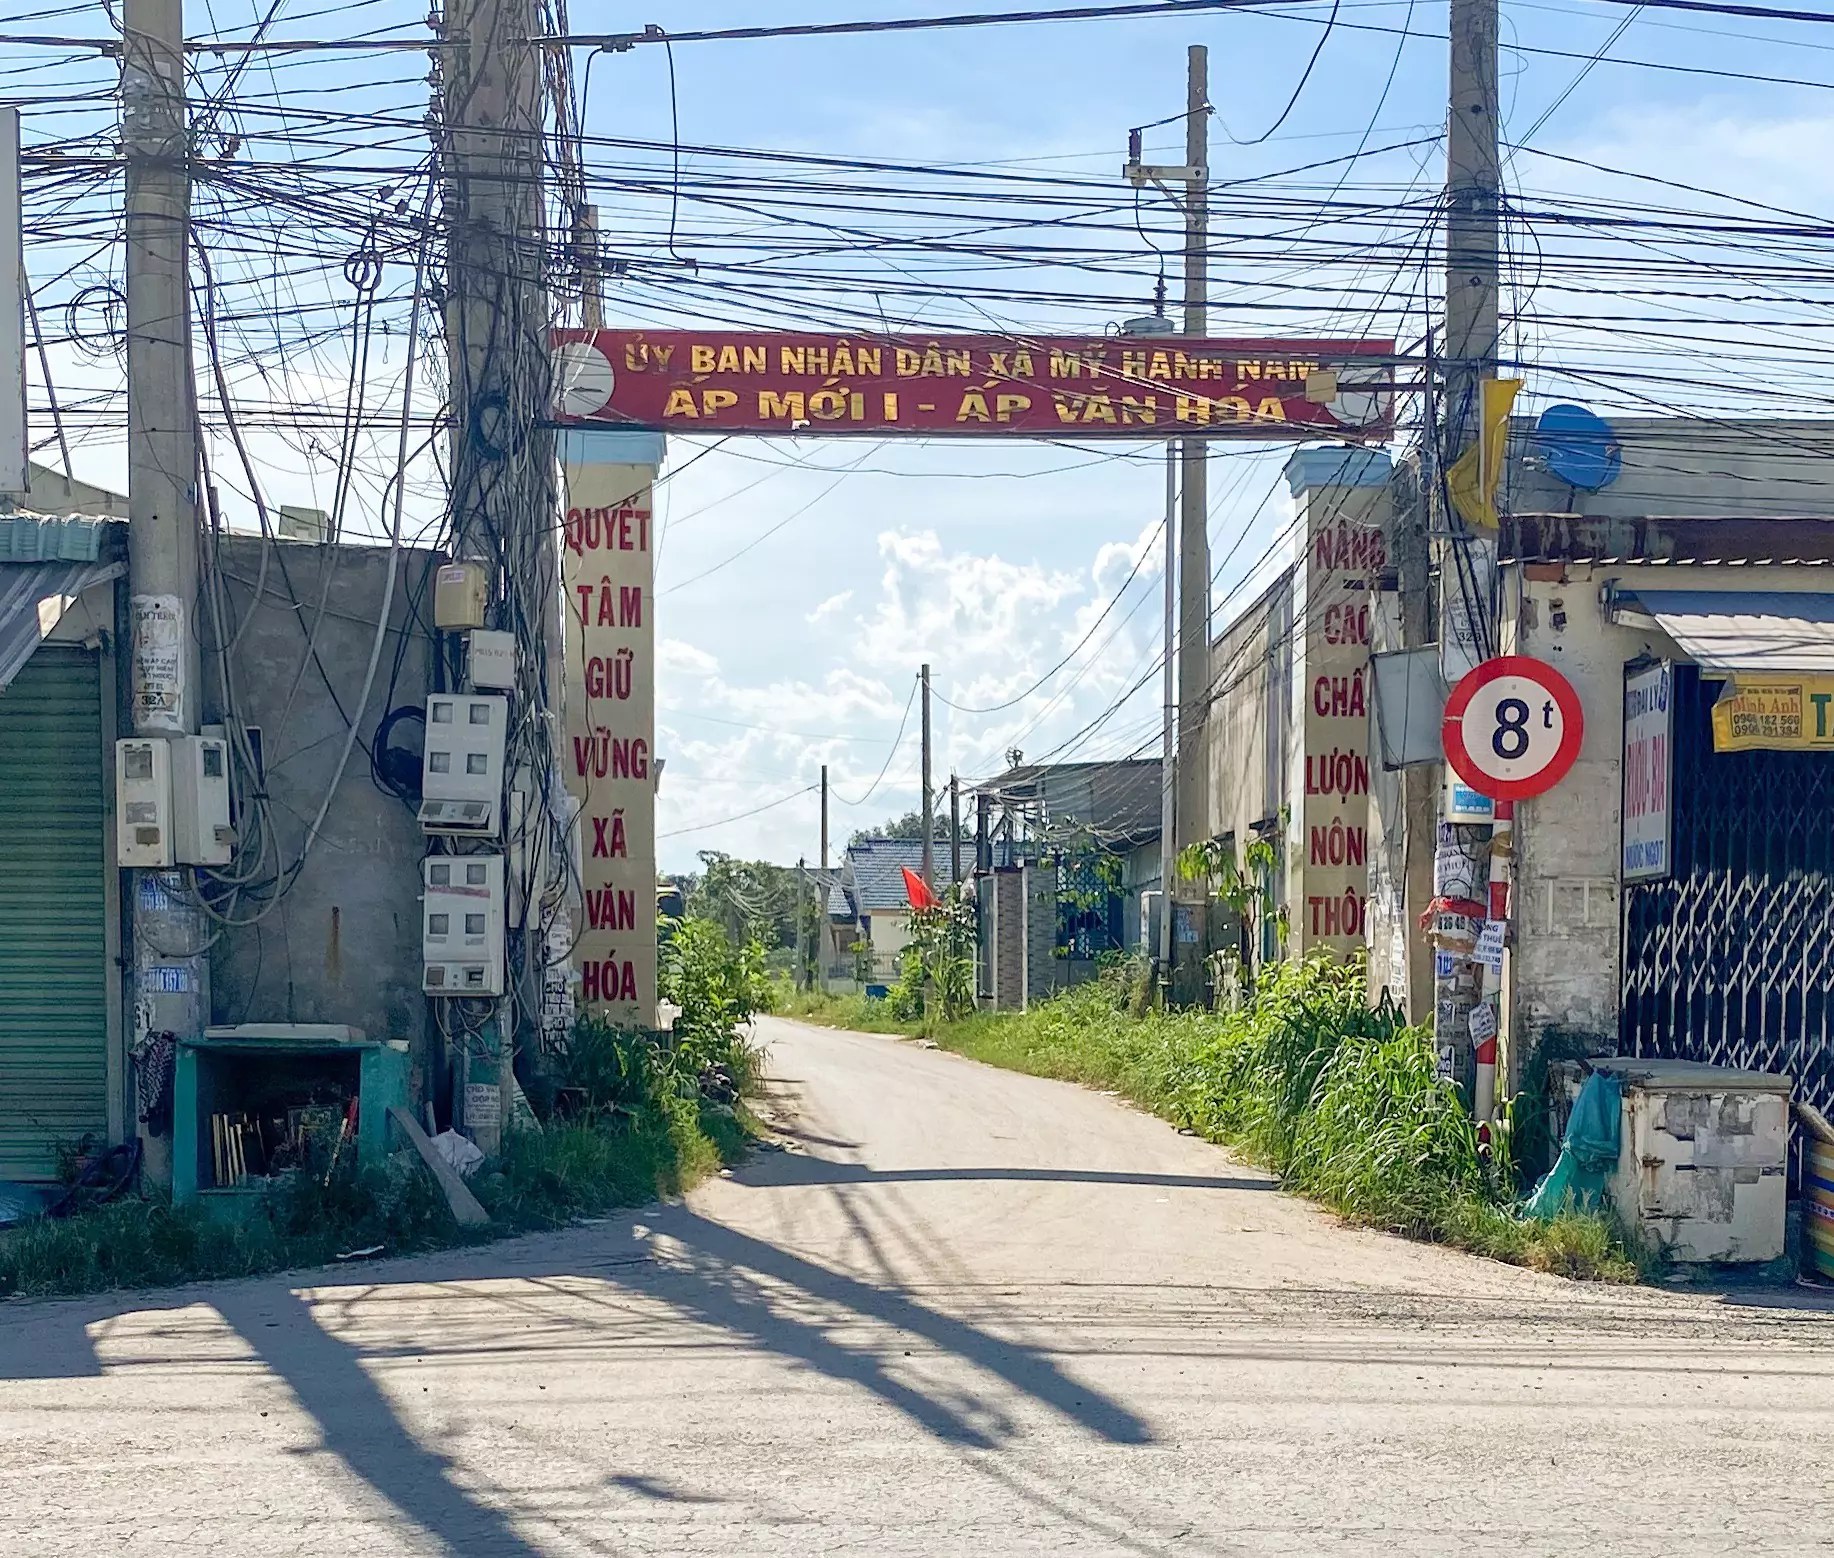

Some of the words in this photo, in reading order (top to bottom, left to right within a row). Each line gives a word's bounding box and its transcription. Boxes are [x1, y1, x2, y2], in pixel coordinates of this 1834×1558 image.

[624, 333, 676, 372] ỦY
[690, 344, 768, 374] BAN
[781, 338, 881, 376] NHÂN
[896, 341, 971, 377] DÂN
[1048, 342, 1108, 379] MỸ
[1237, 352, 1320, 381] NAM
[663, 375, 739, 418] ẤP
[758, 378, 865, 420] MỚI
[956, 380, 1032, 423] ẤP
[1050, 384, 1157, 424] VĂN
[1175, 383, 1287, 425] HÓA
[566, 496, 650, 557] QUYẾT
[1315, 519, 1386, 570] NÂNG
[577, 575, 642, 628] TÂM
[586, 647, 635, 700] GIỮ
[1314, 662, 1368, 717] CHẤ
[1769, 698, 1799, 714] Anh
[573, 726, 648, 780] VỮNG
[1307, 745, 1369, 804] LƯỢN
[592, 808, 628, 858] XÃ
[1311, 816, 1368, 866] NÔN
[585, 881, 636, 930] VĂN
[582, 949, 638, 1002] HÓA
